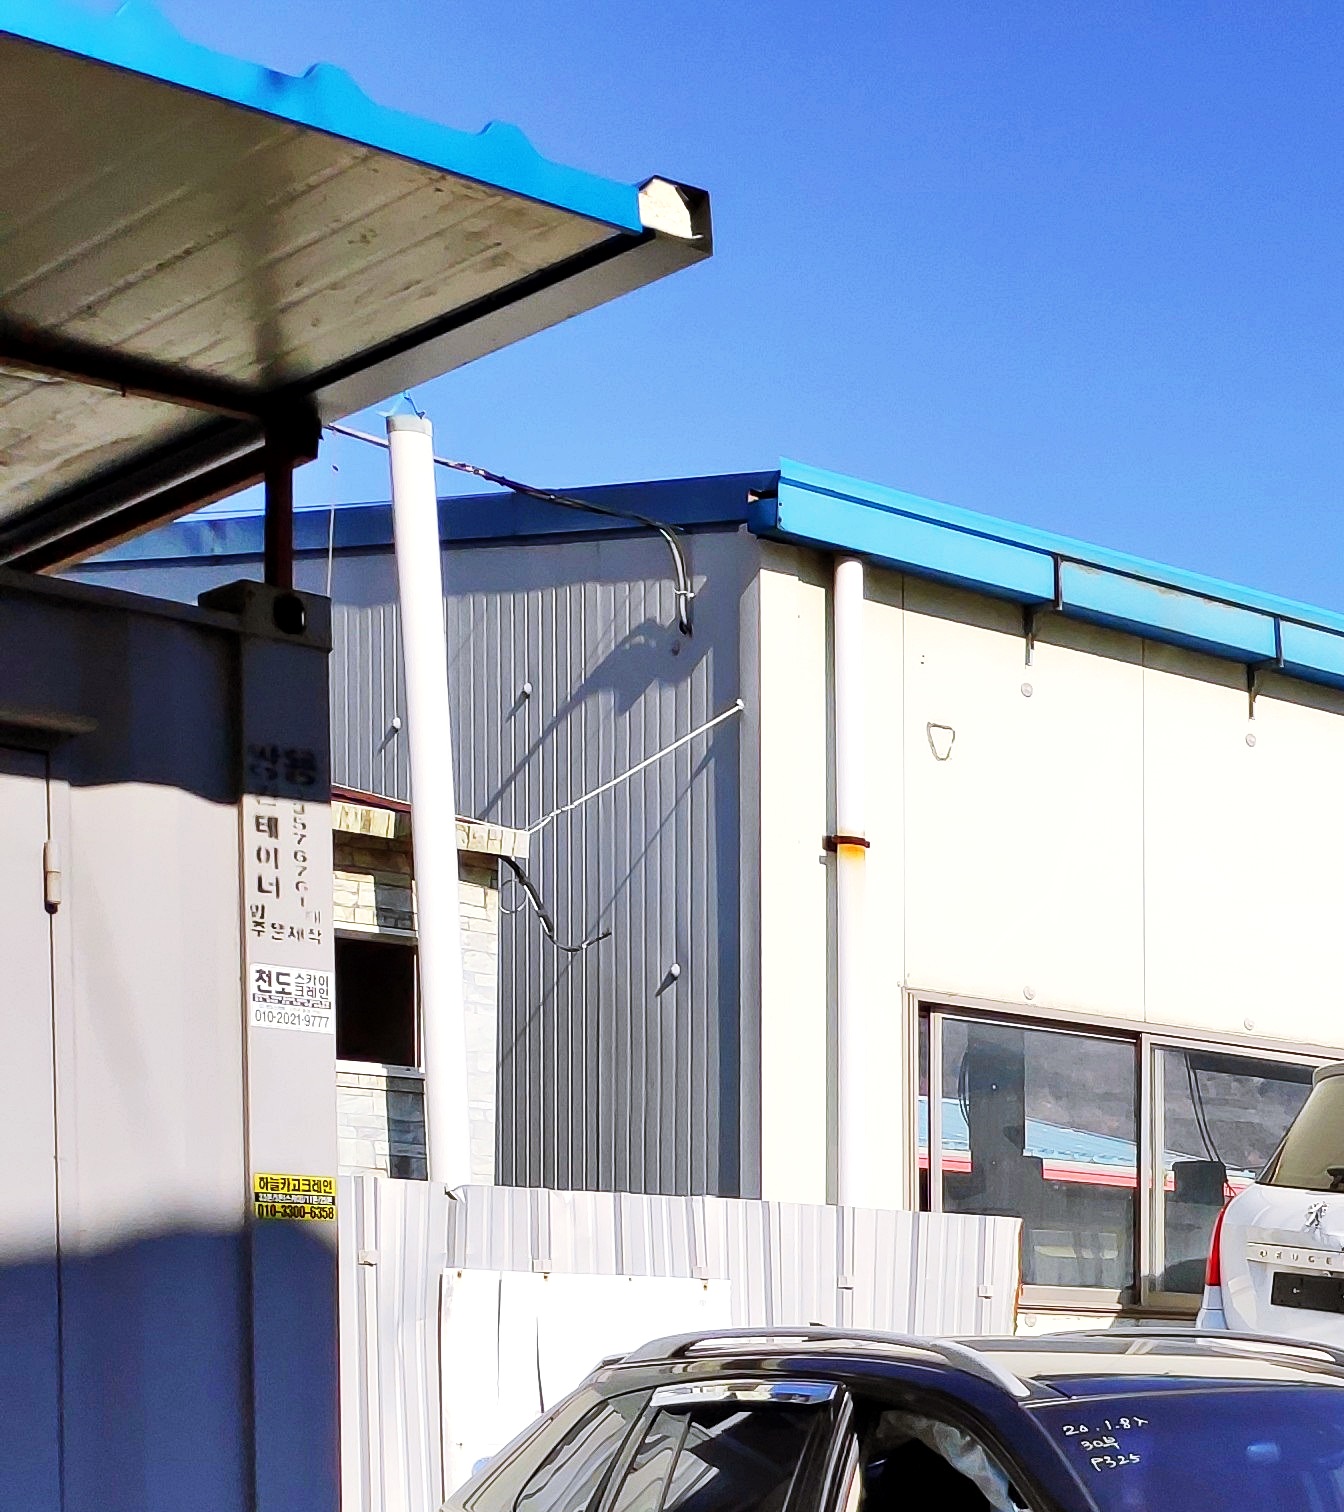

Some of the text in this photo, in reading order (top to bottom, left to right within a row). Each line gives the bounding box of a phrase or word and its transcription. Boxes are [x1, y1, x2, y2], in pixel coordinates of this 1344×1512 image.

[294, 973, 330, 988] 스카이
[294, 985, 330, 1001] 크레인
[258, 1176, 333, 1194] 하늘카고크레인
